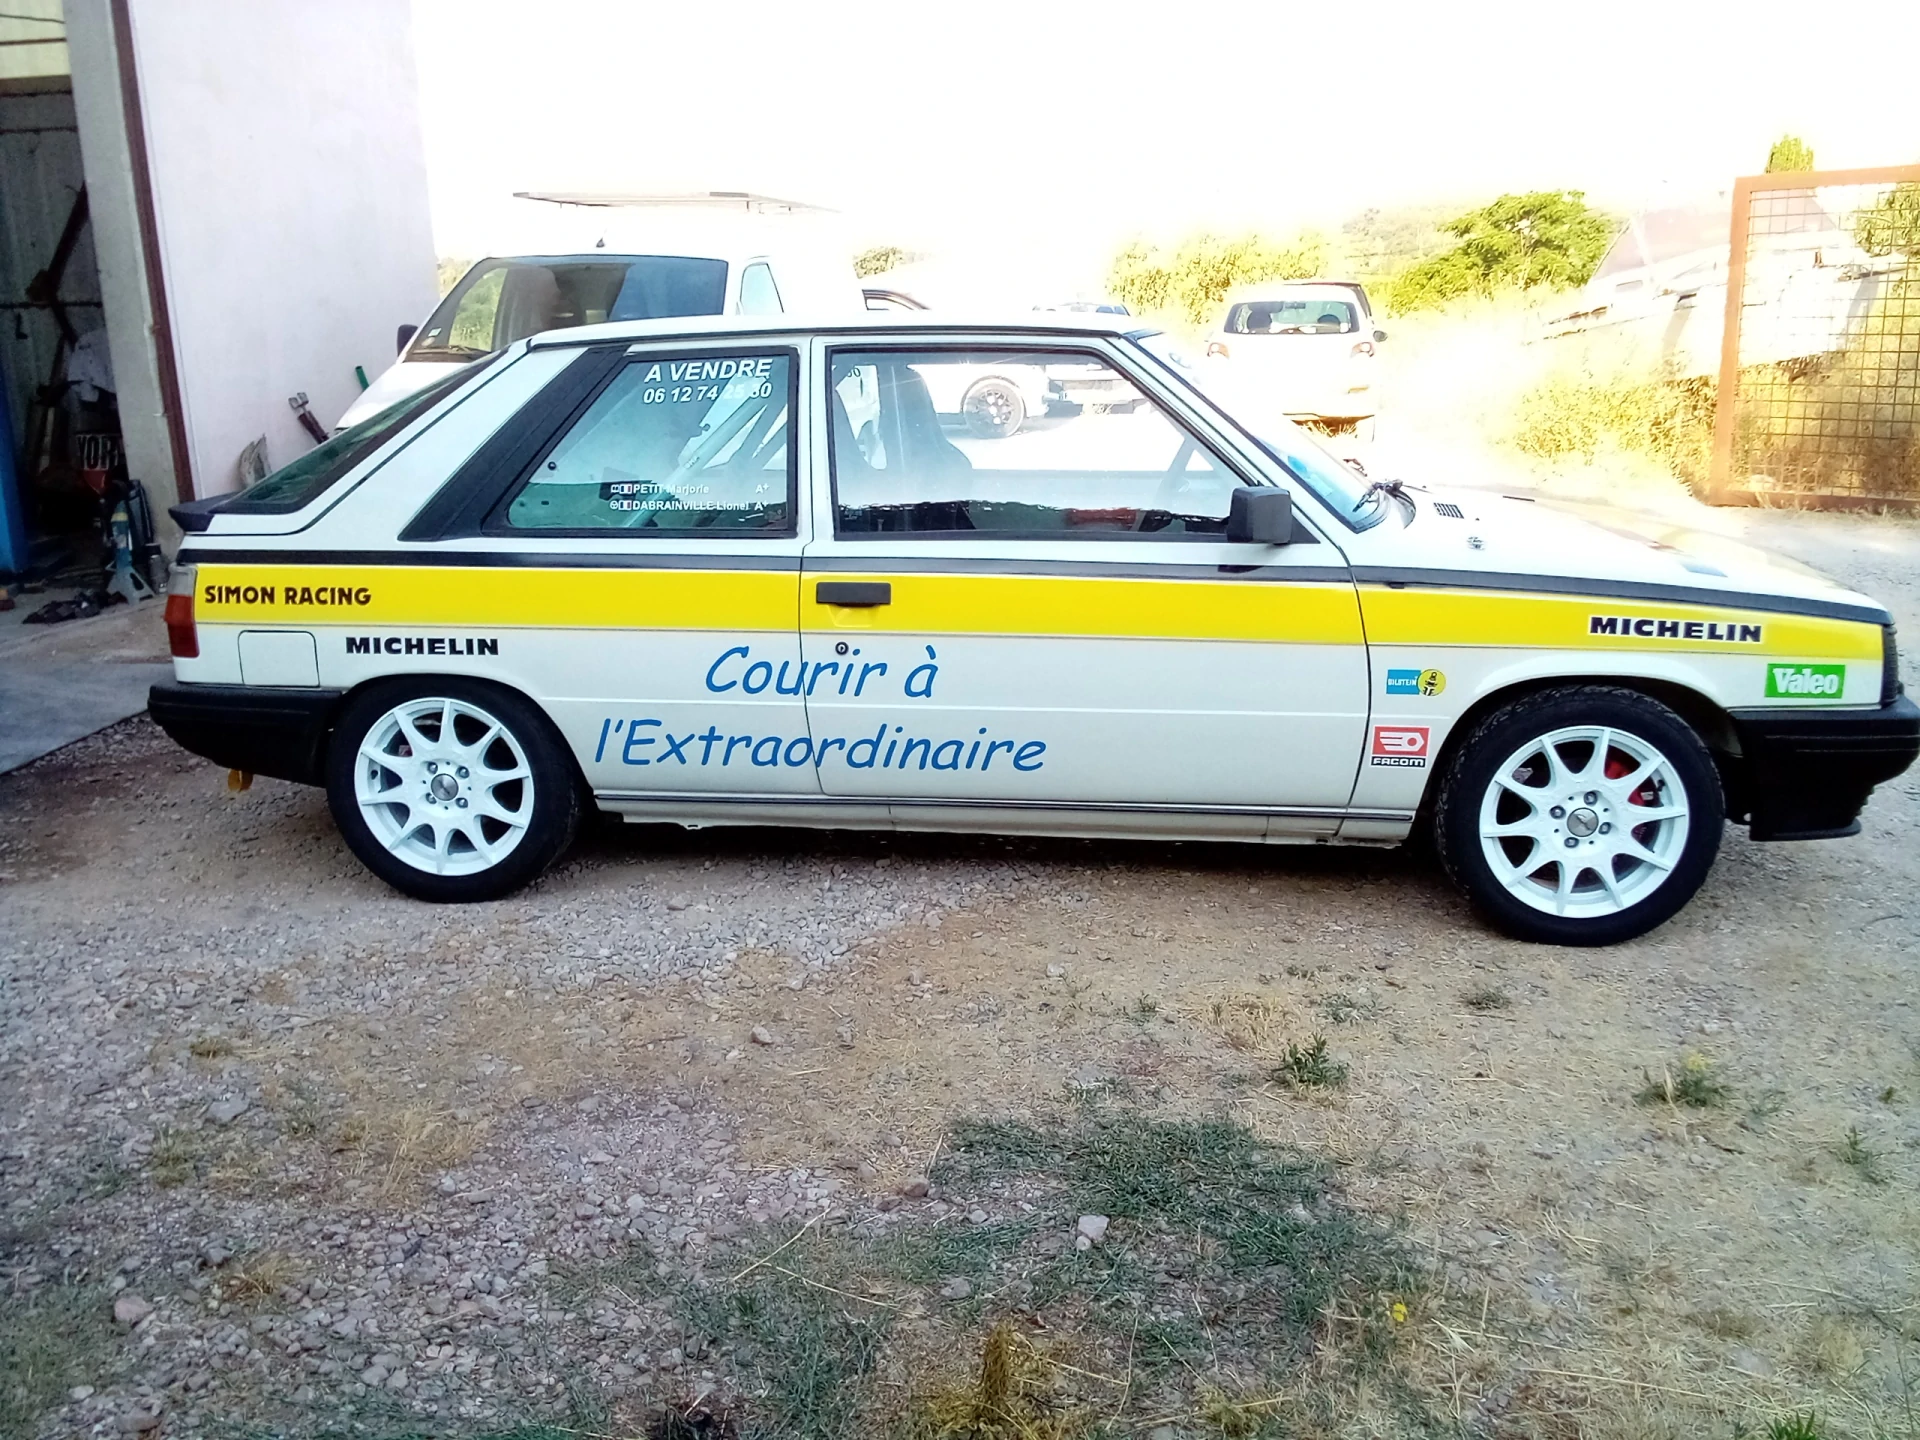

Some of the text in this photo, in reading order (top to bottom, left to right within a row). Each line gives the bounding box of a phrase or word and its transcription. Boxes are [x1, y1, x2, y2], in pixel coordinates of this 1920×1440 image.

[643, 358, 773, 383] A VENDRE
[643, 387, 667, 404] 06
[670, 386, 694, 403] 12
[696, 385, 719, 401] 74
[633, 484, 664, 494] PETIT
[668, 484, 710, 496] Marjorie
[633, 500, 714, 511] DABRAINVILLE
[716, 501, 750, 511] Lionel
[204, 585, 372, 606] SIMON RACING
[1589, 616, 1763, 643] MICHELIN
[346, 636, 499, 656] MICHELIN
[705, 644, 940, 698] Courir à
[1772, 667, 1839, 694] Valeo
[594, 718, 1048, 772] l'Extraordinaire
[1372, 756, 1425, 767] FACOM
